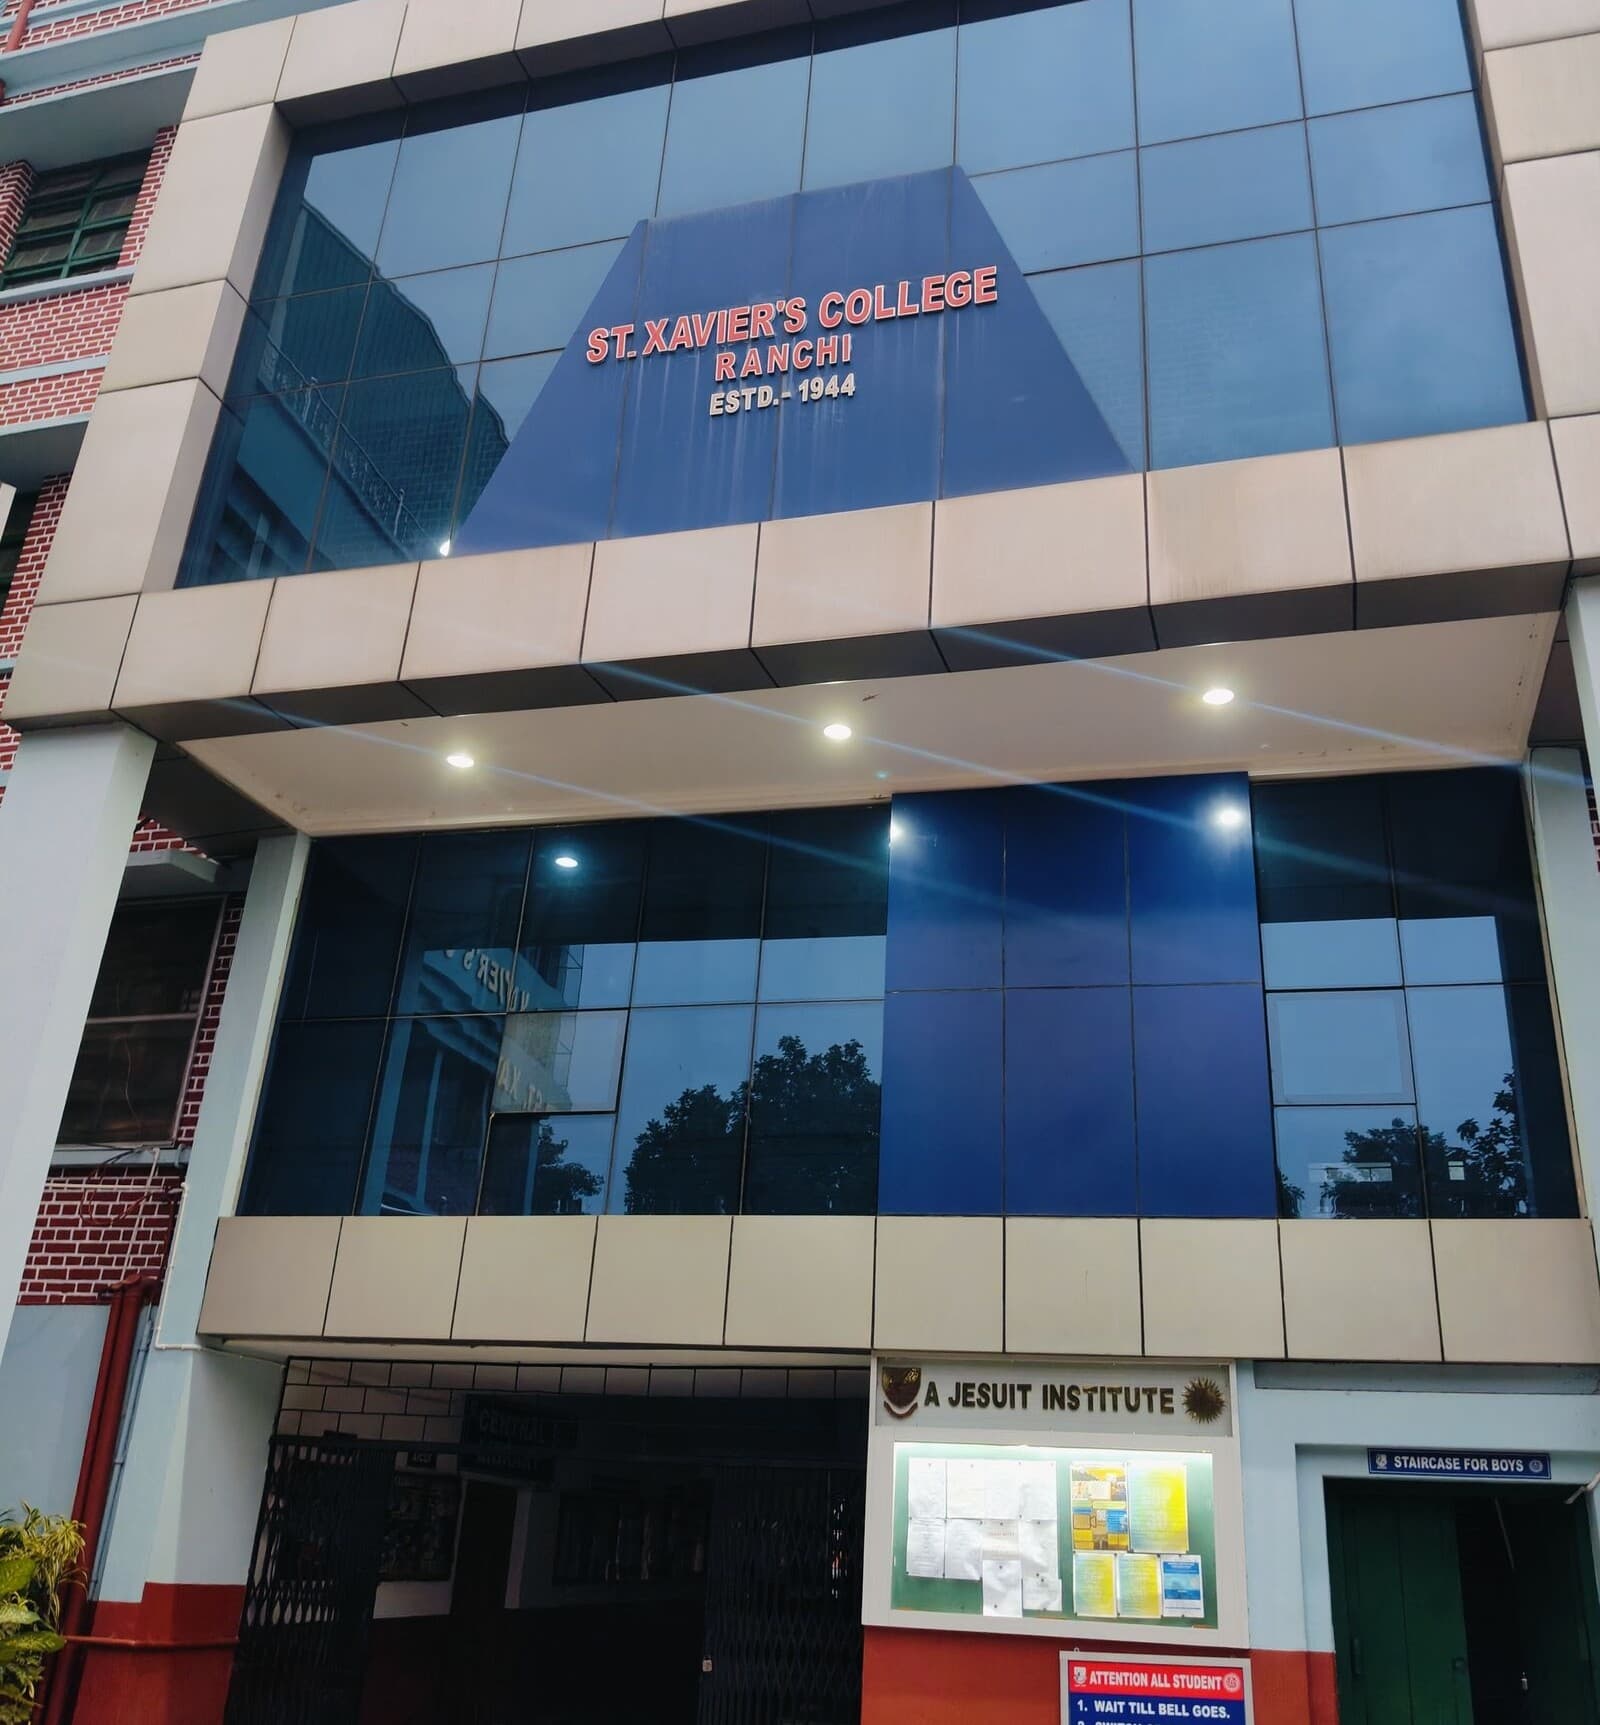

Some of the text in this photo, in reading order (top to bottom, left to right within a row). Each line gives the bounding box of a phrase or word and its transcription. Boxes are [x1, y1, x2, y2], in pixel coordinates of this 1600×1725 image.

[586, 265, 998, 365] ST. XAVIER'S COLLEGE
[714, 333, 852, 382] RANCHI
[798, 373, 856, 404] 1944
[924, 1381, 1175, 1414] A JESUIT INSTITUTE
[1394, 1455, 1524, 1473] STAIRCASE FOR BOYS
[1089, 1670, 1222, 1690] ATTENTION ALL STUDENT
[1077, 1699, 1231, 1719] 1. WAIT TILL BELL GOES.
